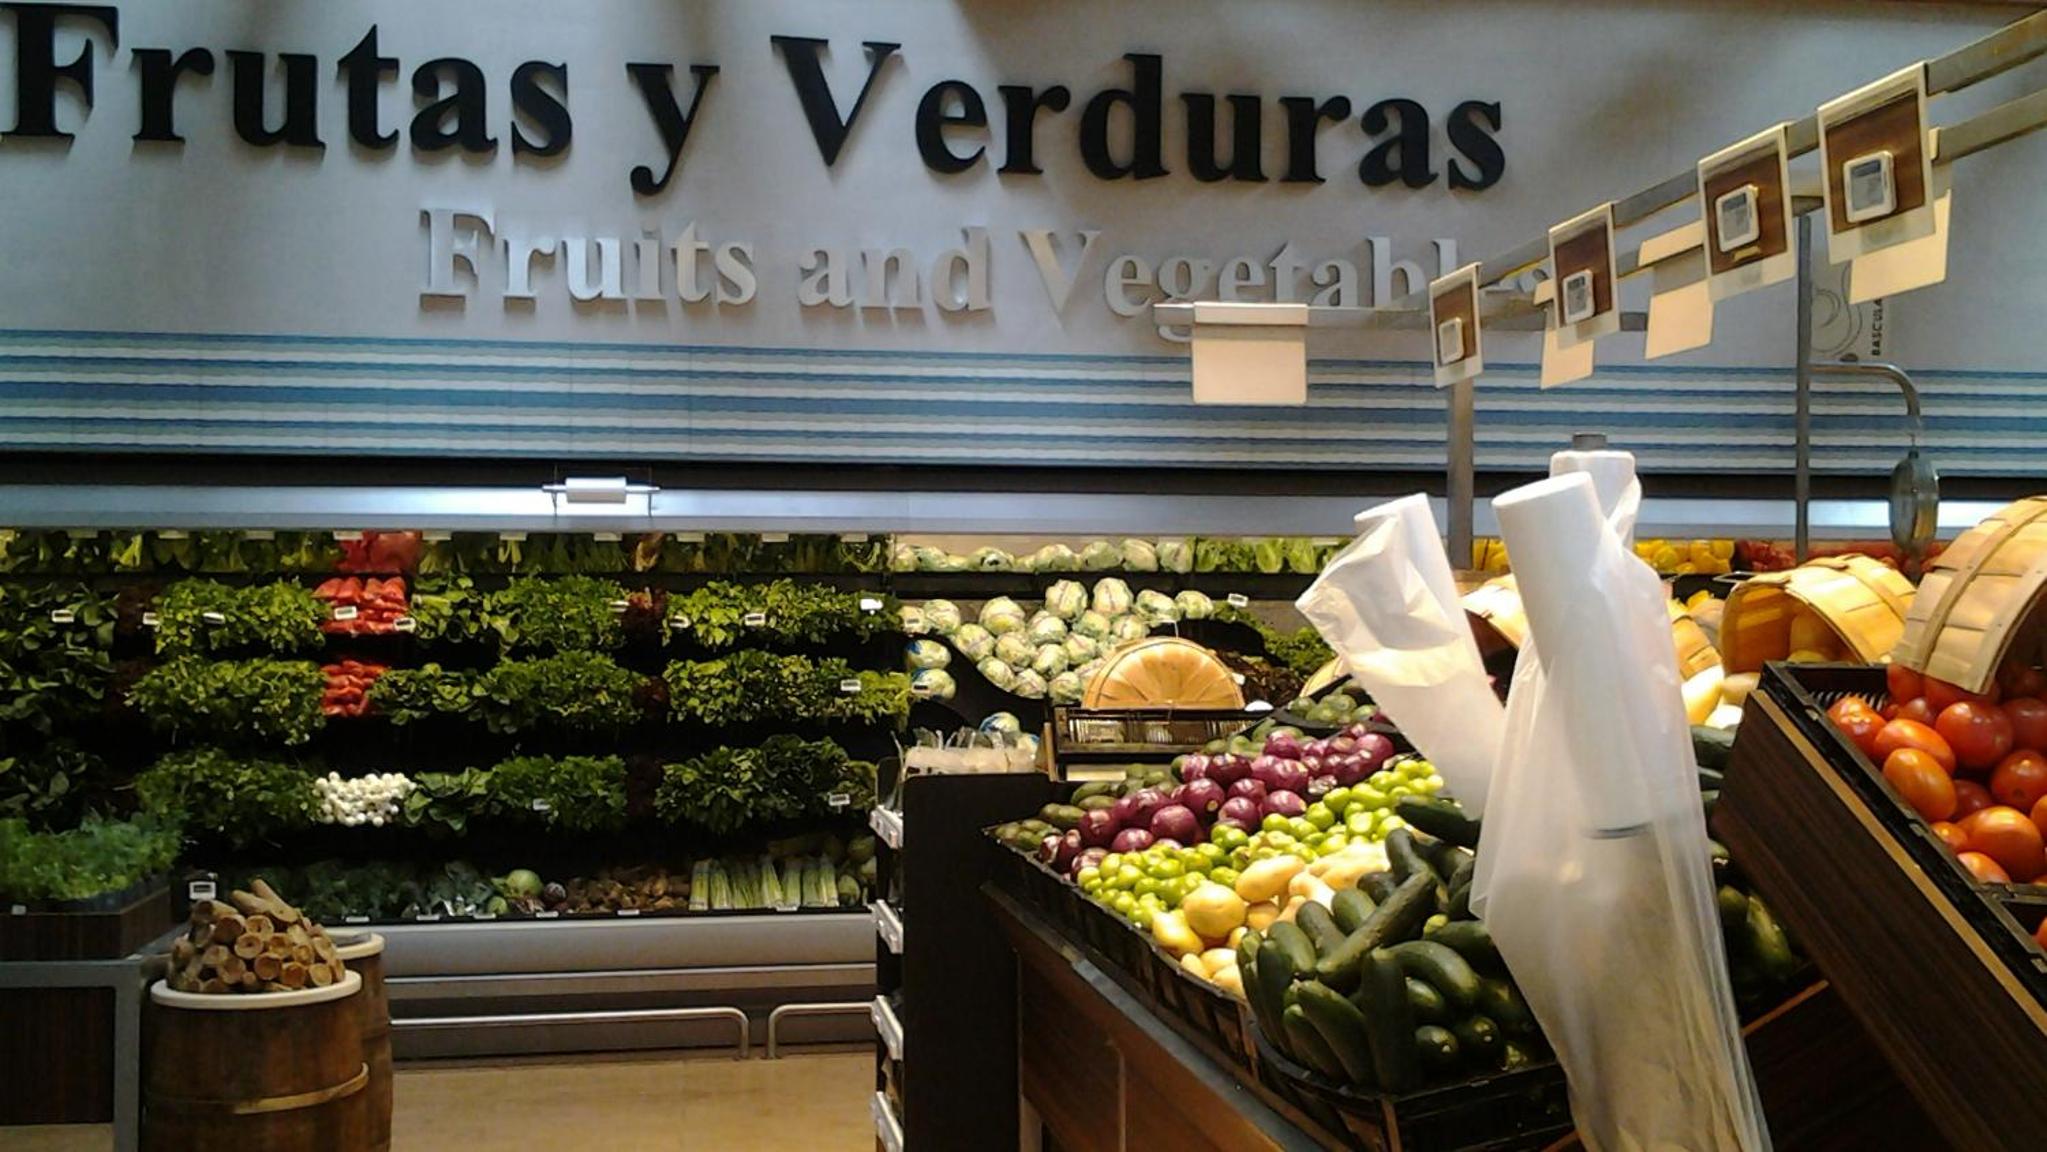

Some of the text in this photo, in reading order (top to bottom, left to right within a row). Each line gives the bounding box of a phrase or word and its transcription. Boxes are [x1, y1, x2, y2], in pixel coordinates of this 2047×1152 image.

[0, 3, 1506, 195] Frutas y Verduras
[420, 208, 1556, 342] Fruits and Vegetab
